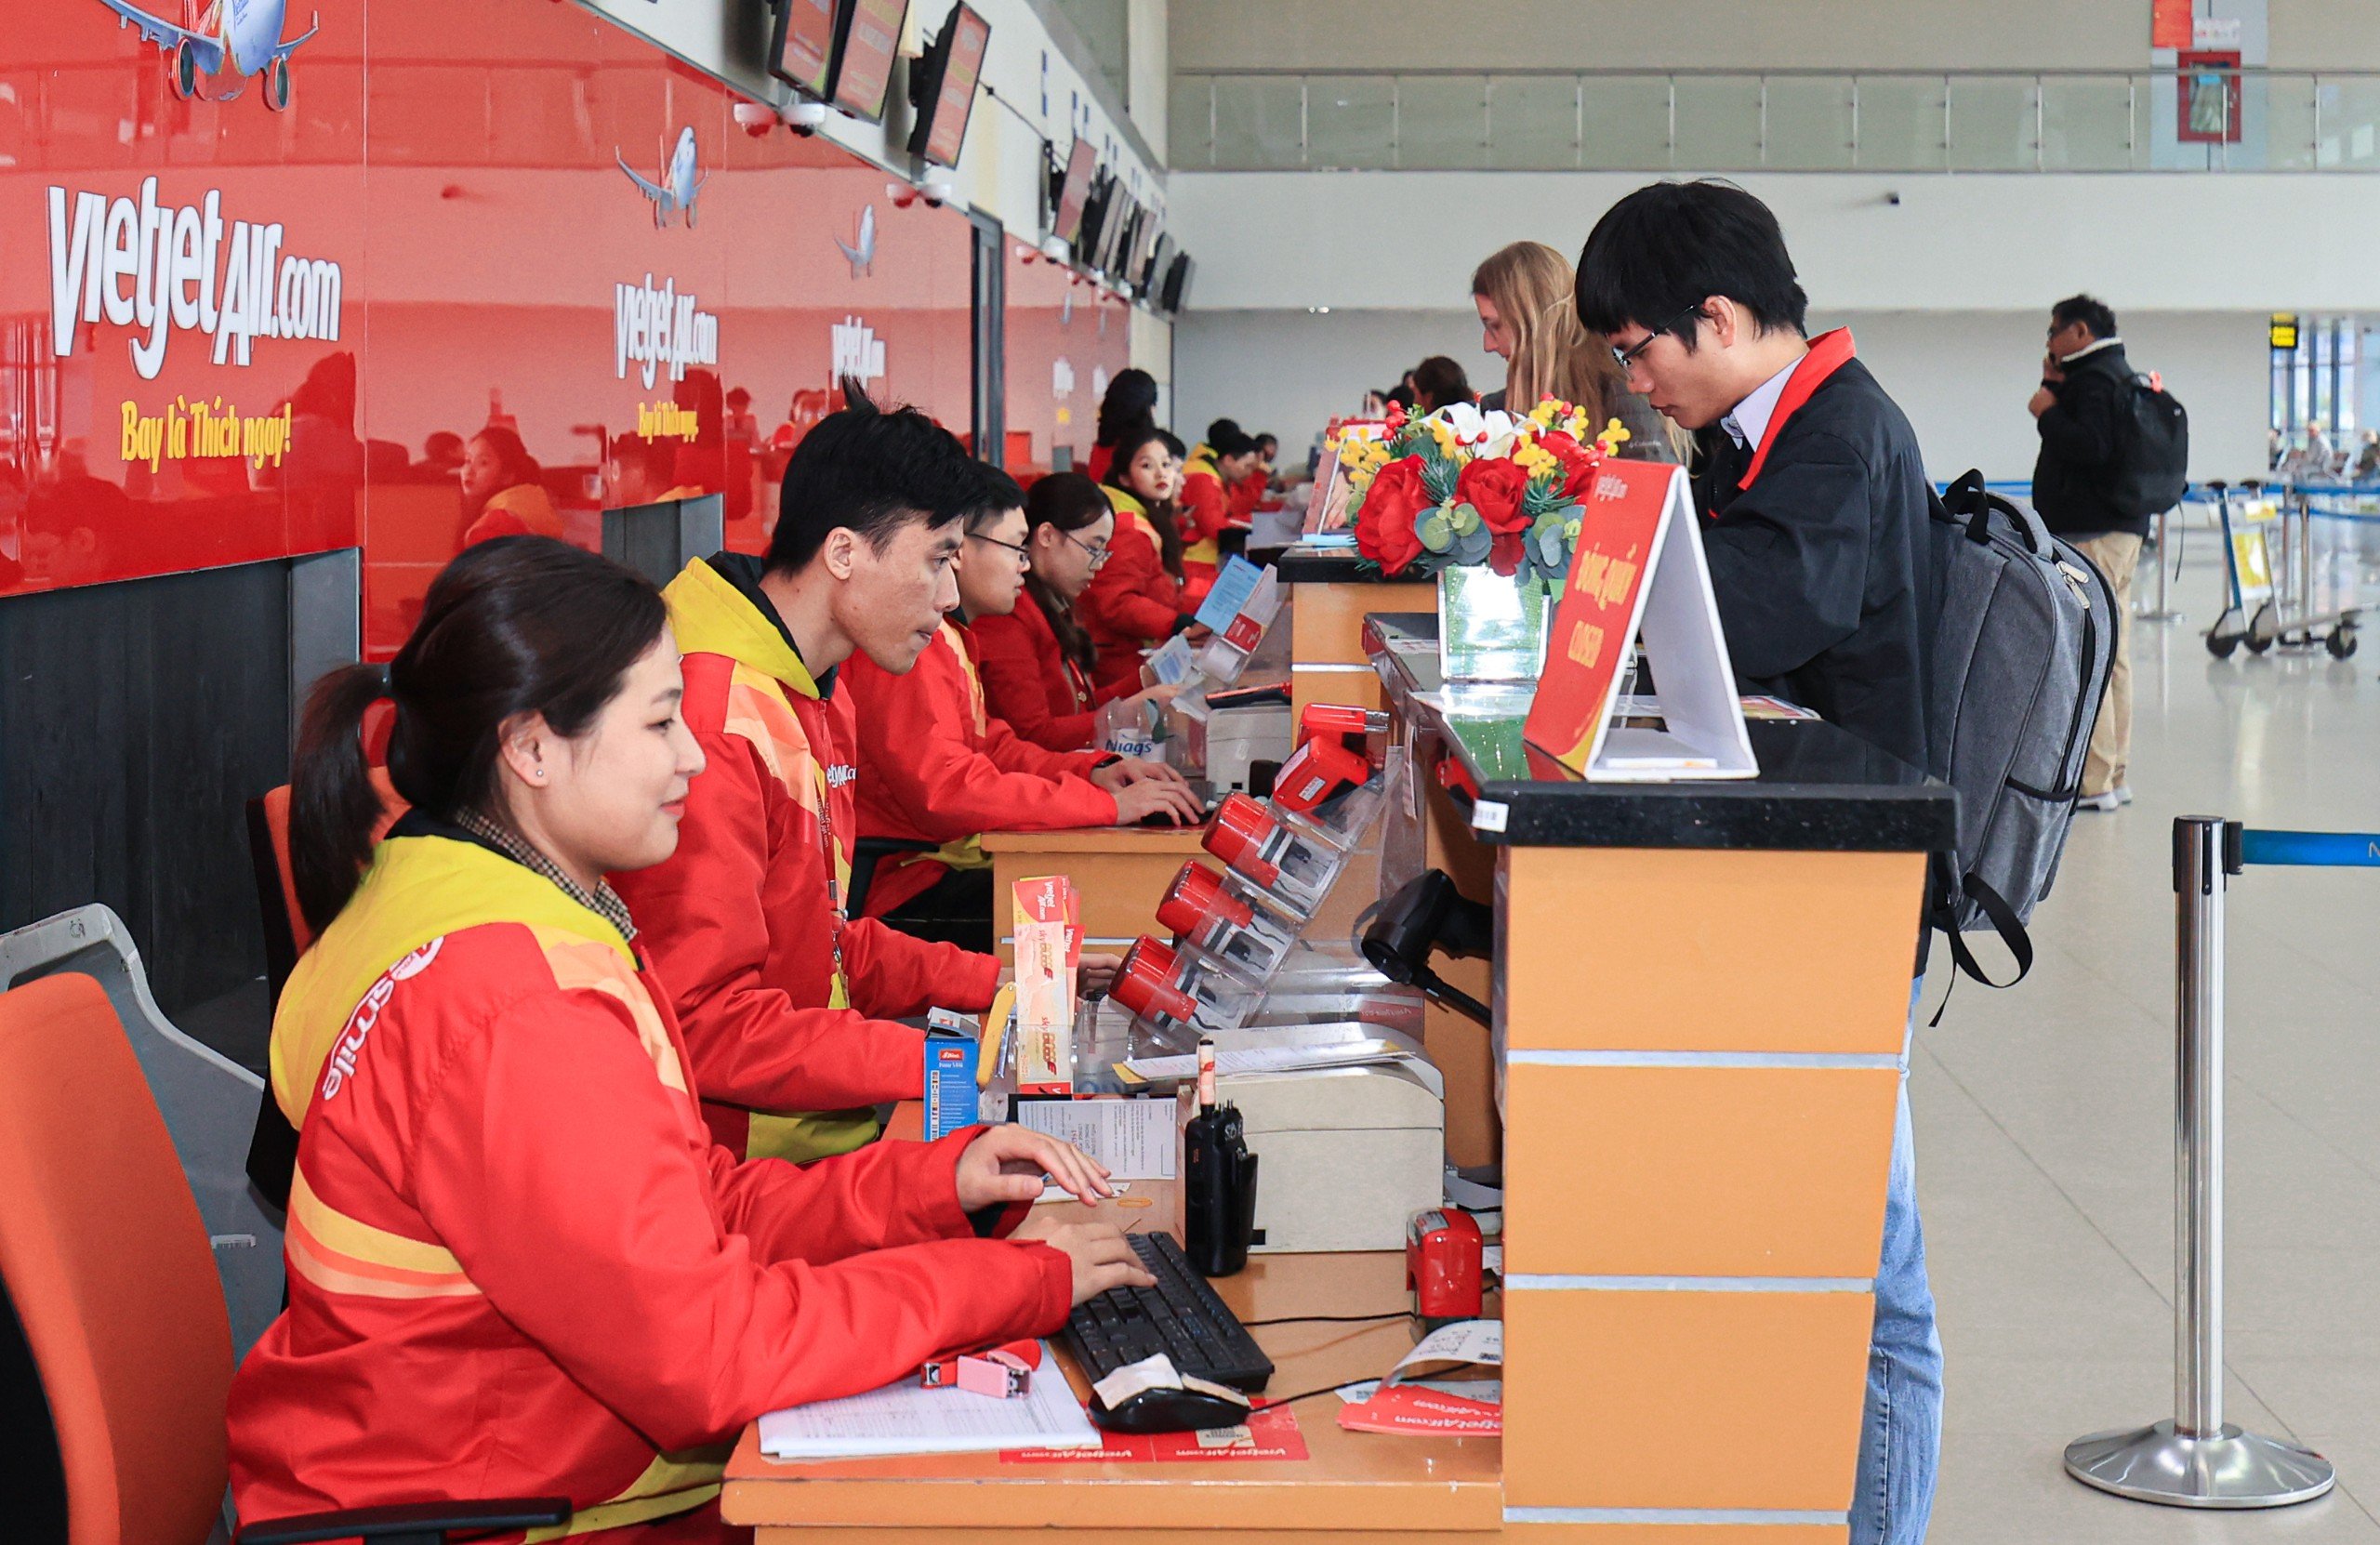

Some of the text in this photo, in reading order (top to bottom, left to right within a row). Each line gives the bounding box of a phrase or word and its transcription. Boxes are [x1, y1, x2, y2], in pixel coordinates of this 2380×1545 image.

[121, 394, 292, 474] Bay là Thích ngay!
